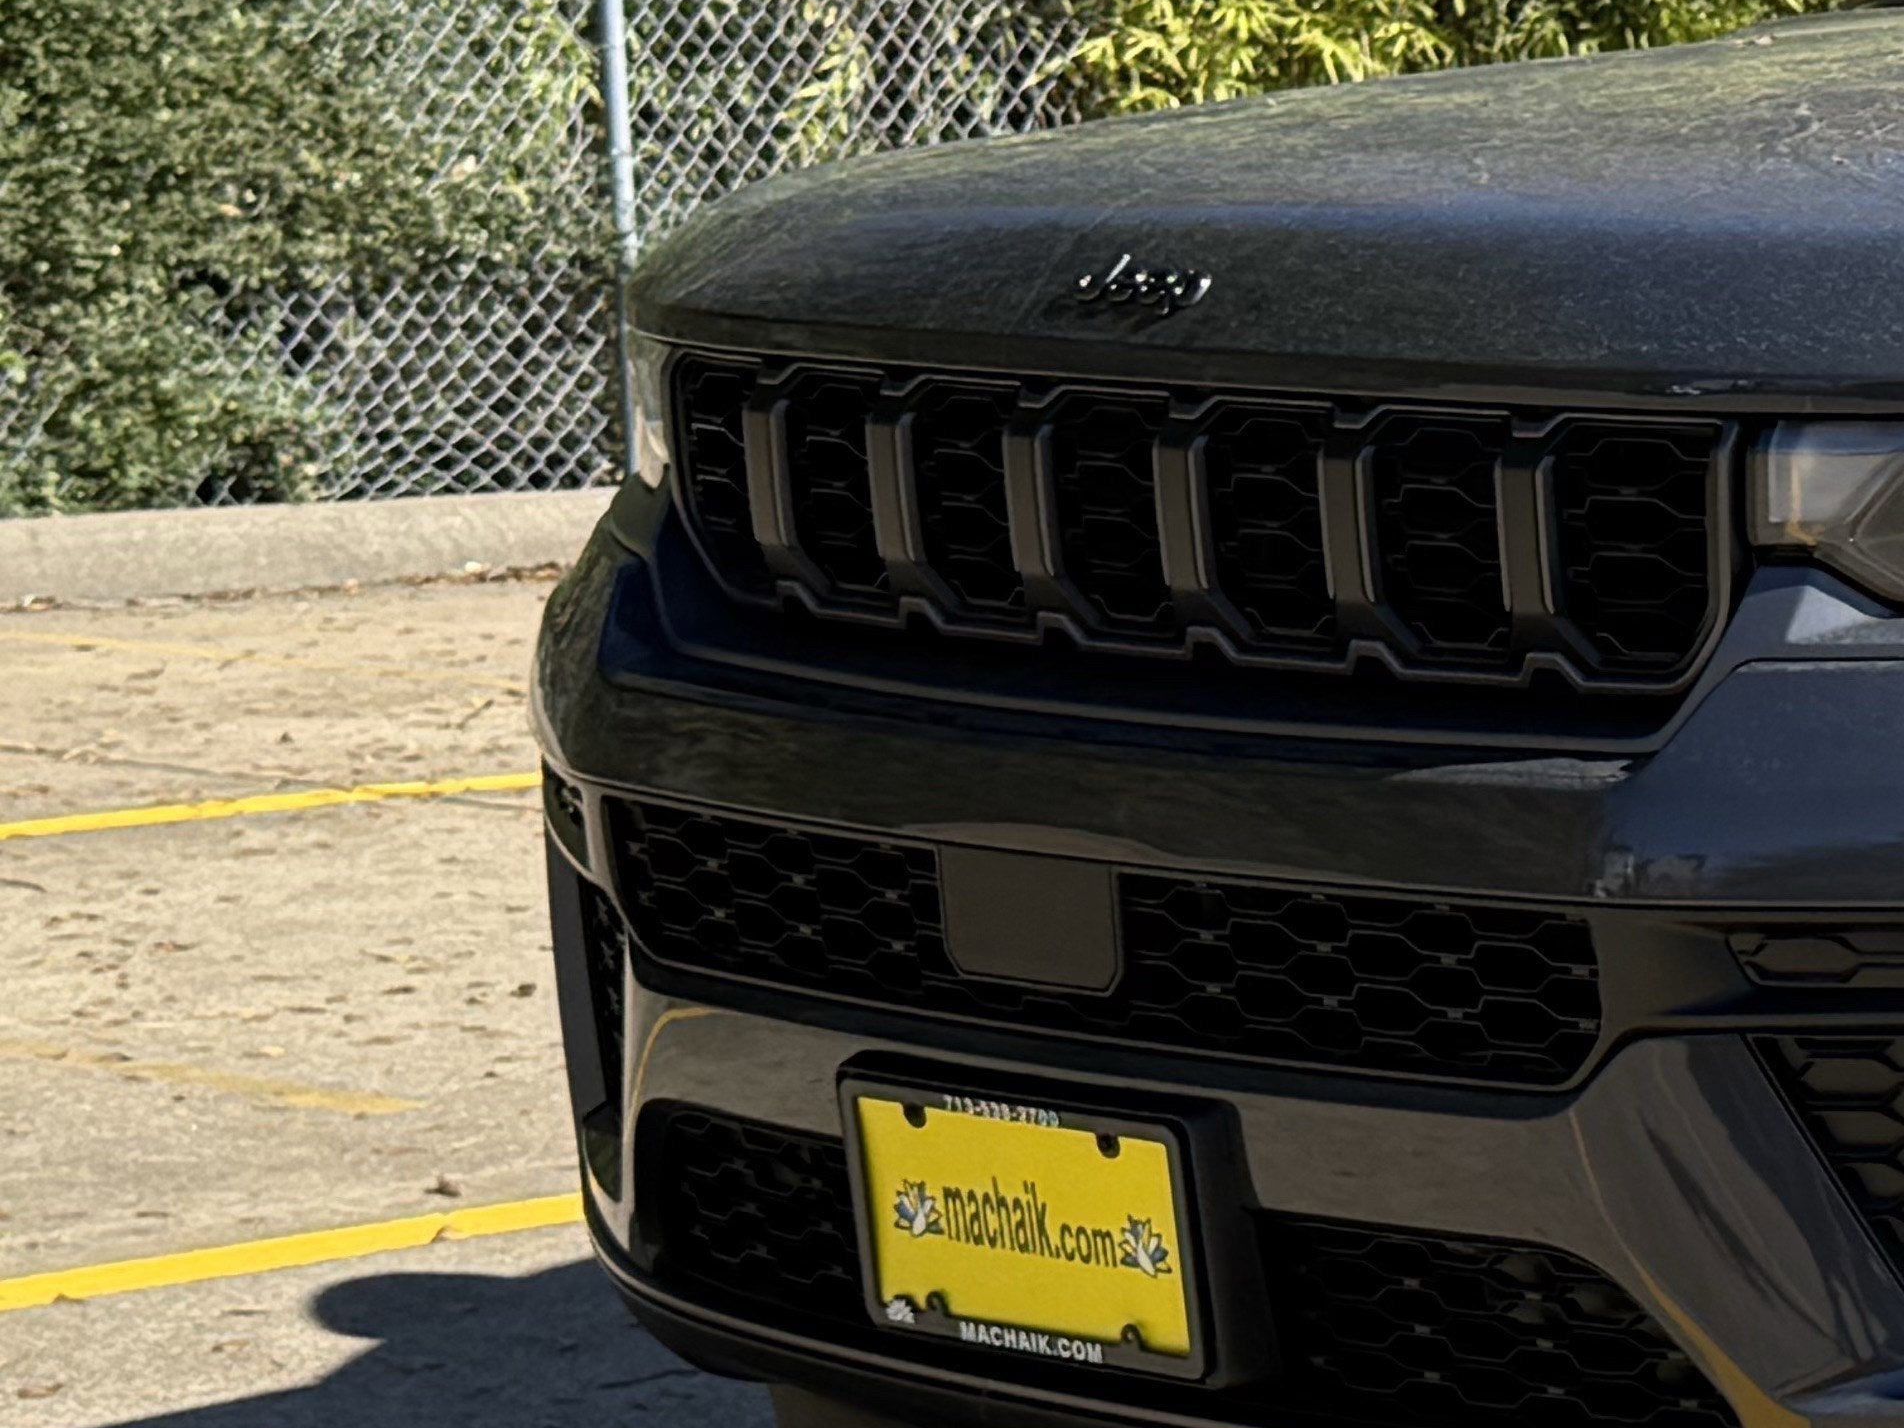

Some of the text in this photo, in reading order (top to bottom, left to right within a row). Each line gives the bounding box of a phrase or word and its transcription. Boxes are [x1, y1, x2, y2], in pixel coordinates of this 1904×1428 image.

[1070, 252, 1213, 316] Jeep
[942, 1176, 1118, 1268] machaik.com
[959, 1321, 1104, 1364] MACHAIK.COM
